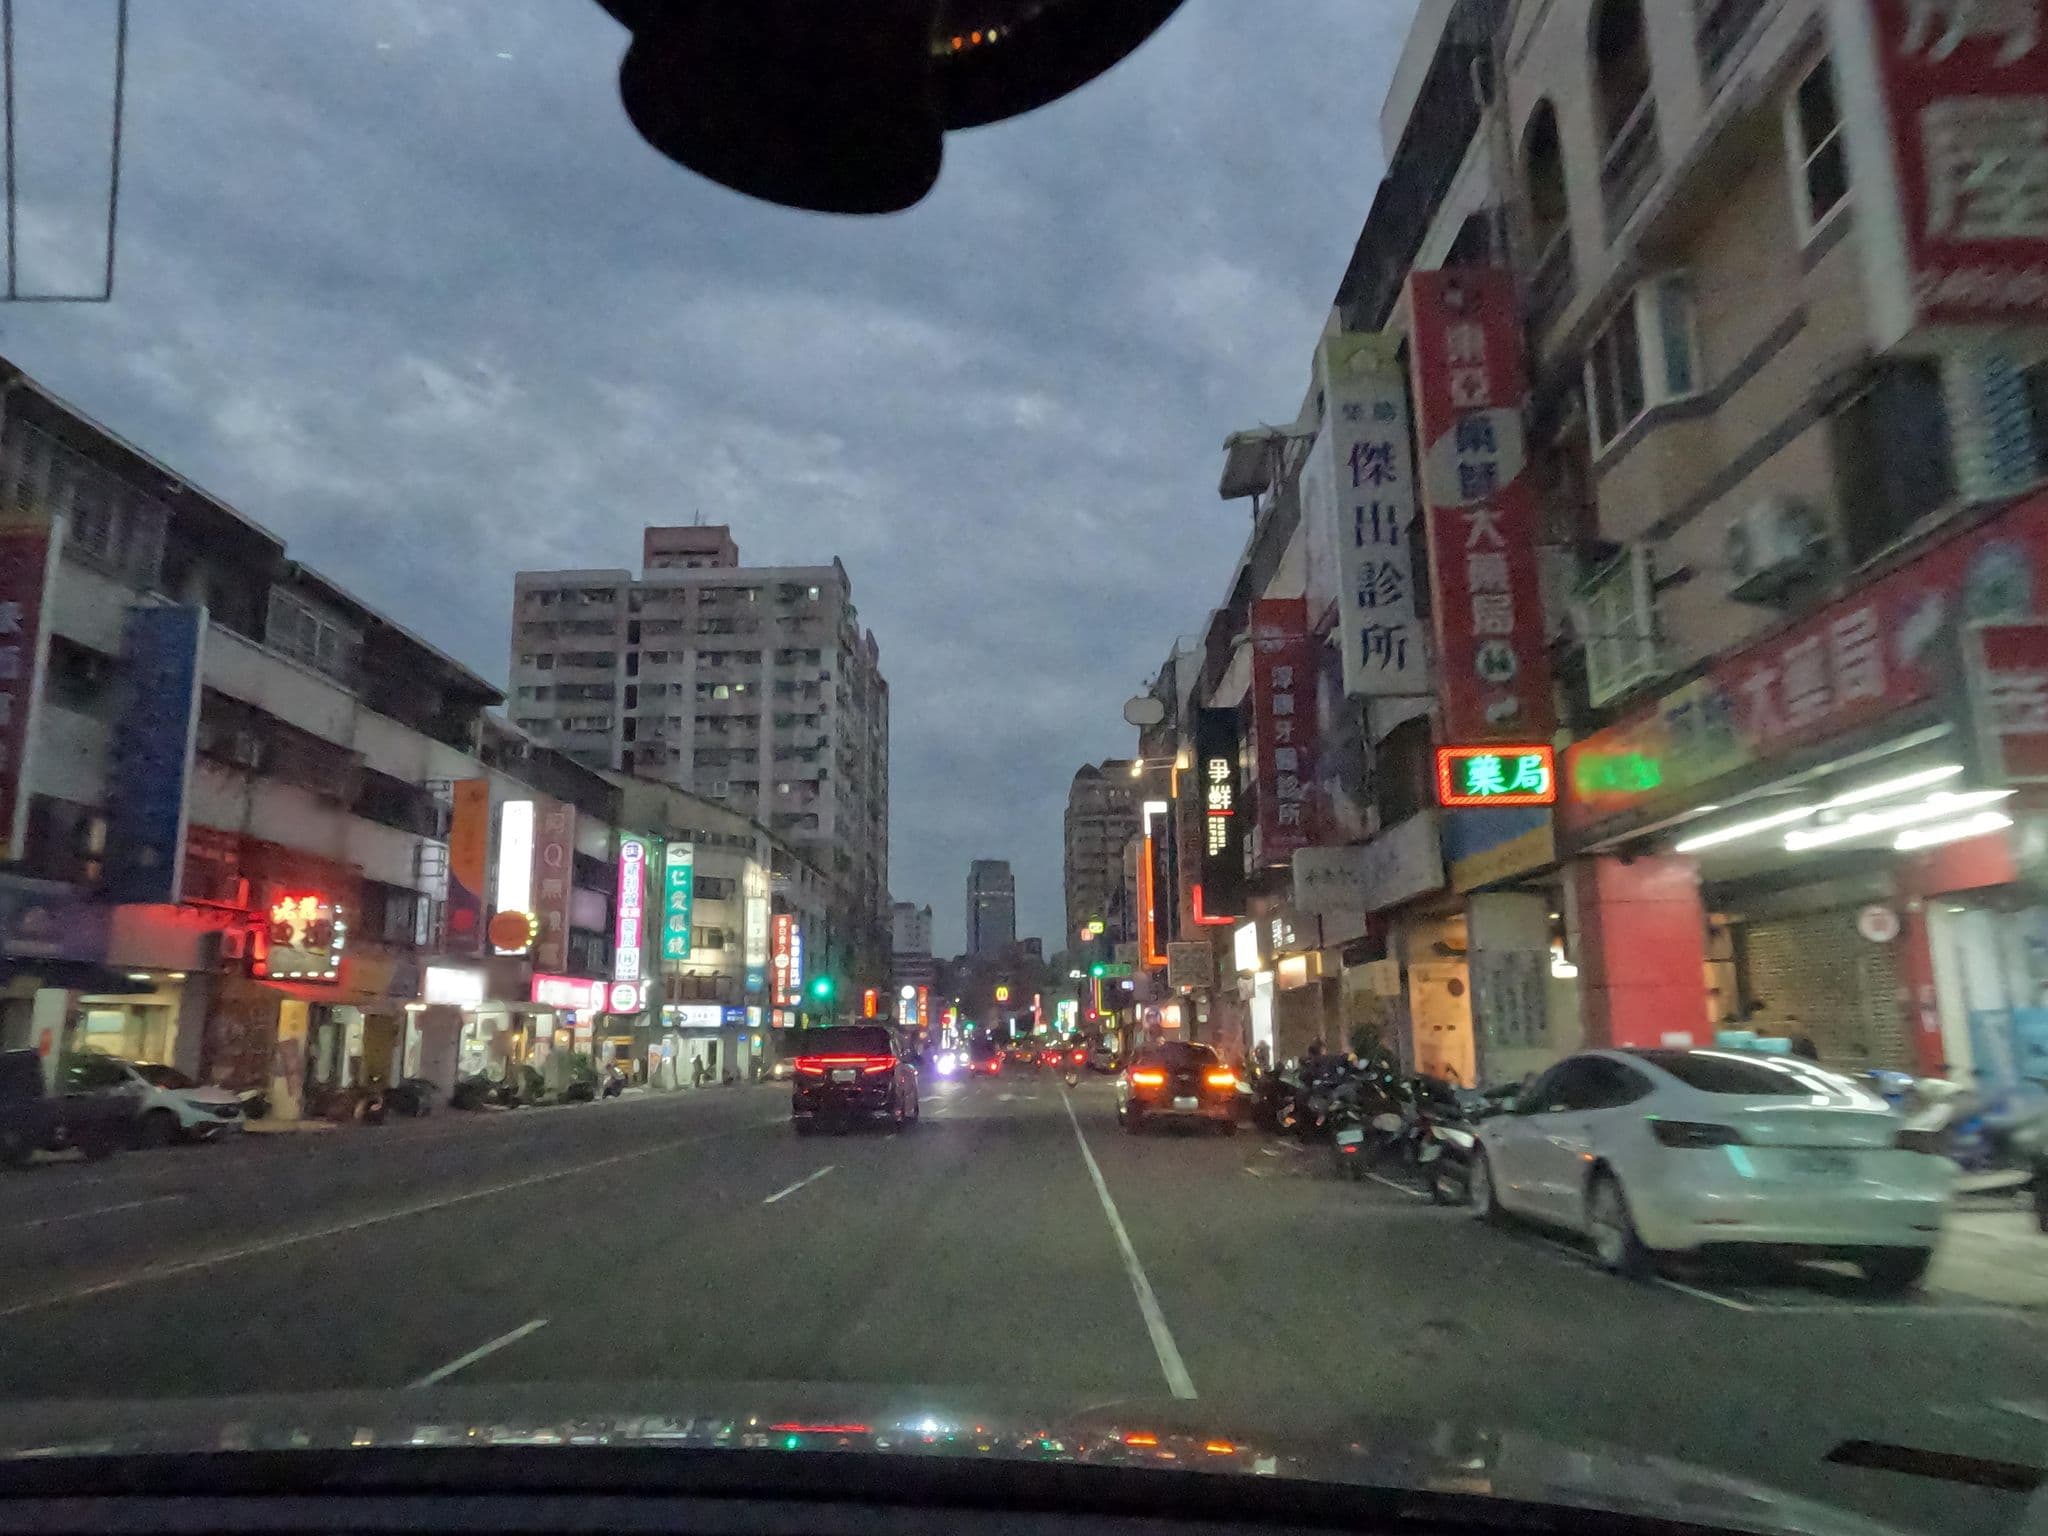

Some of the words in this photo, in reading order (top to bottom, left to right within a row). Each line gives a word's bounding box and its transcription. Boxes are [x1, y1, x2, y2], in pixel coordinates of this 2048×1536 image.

[1348, 440, 1408, 672] 傑出診所
[1466, 754, 1551, 796] 藥局
